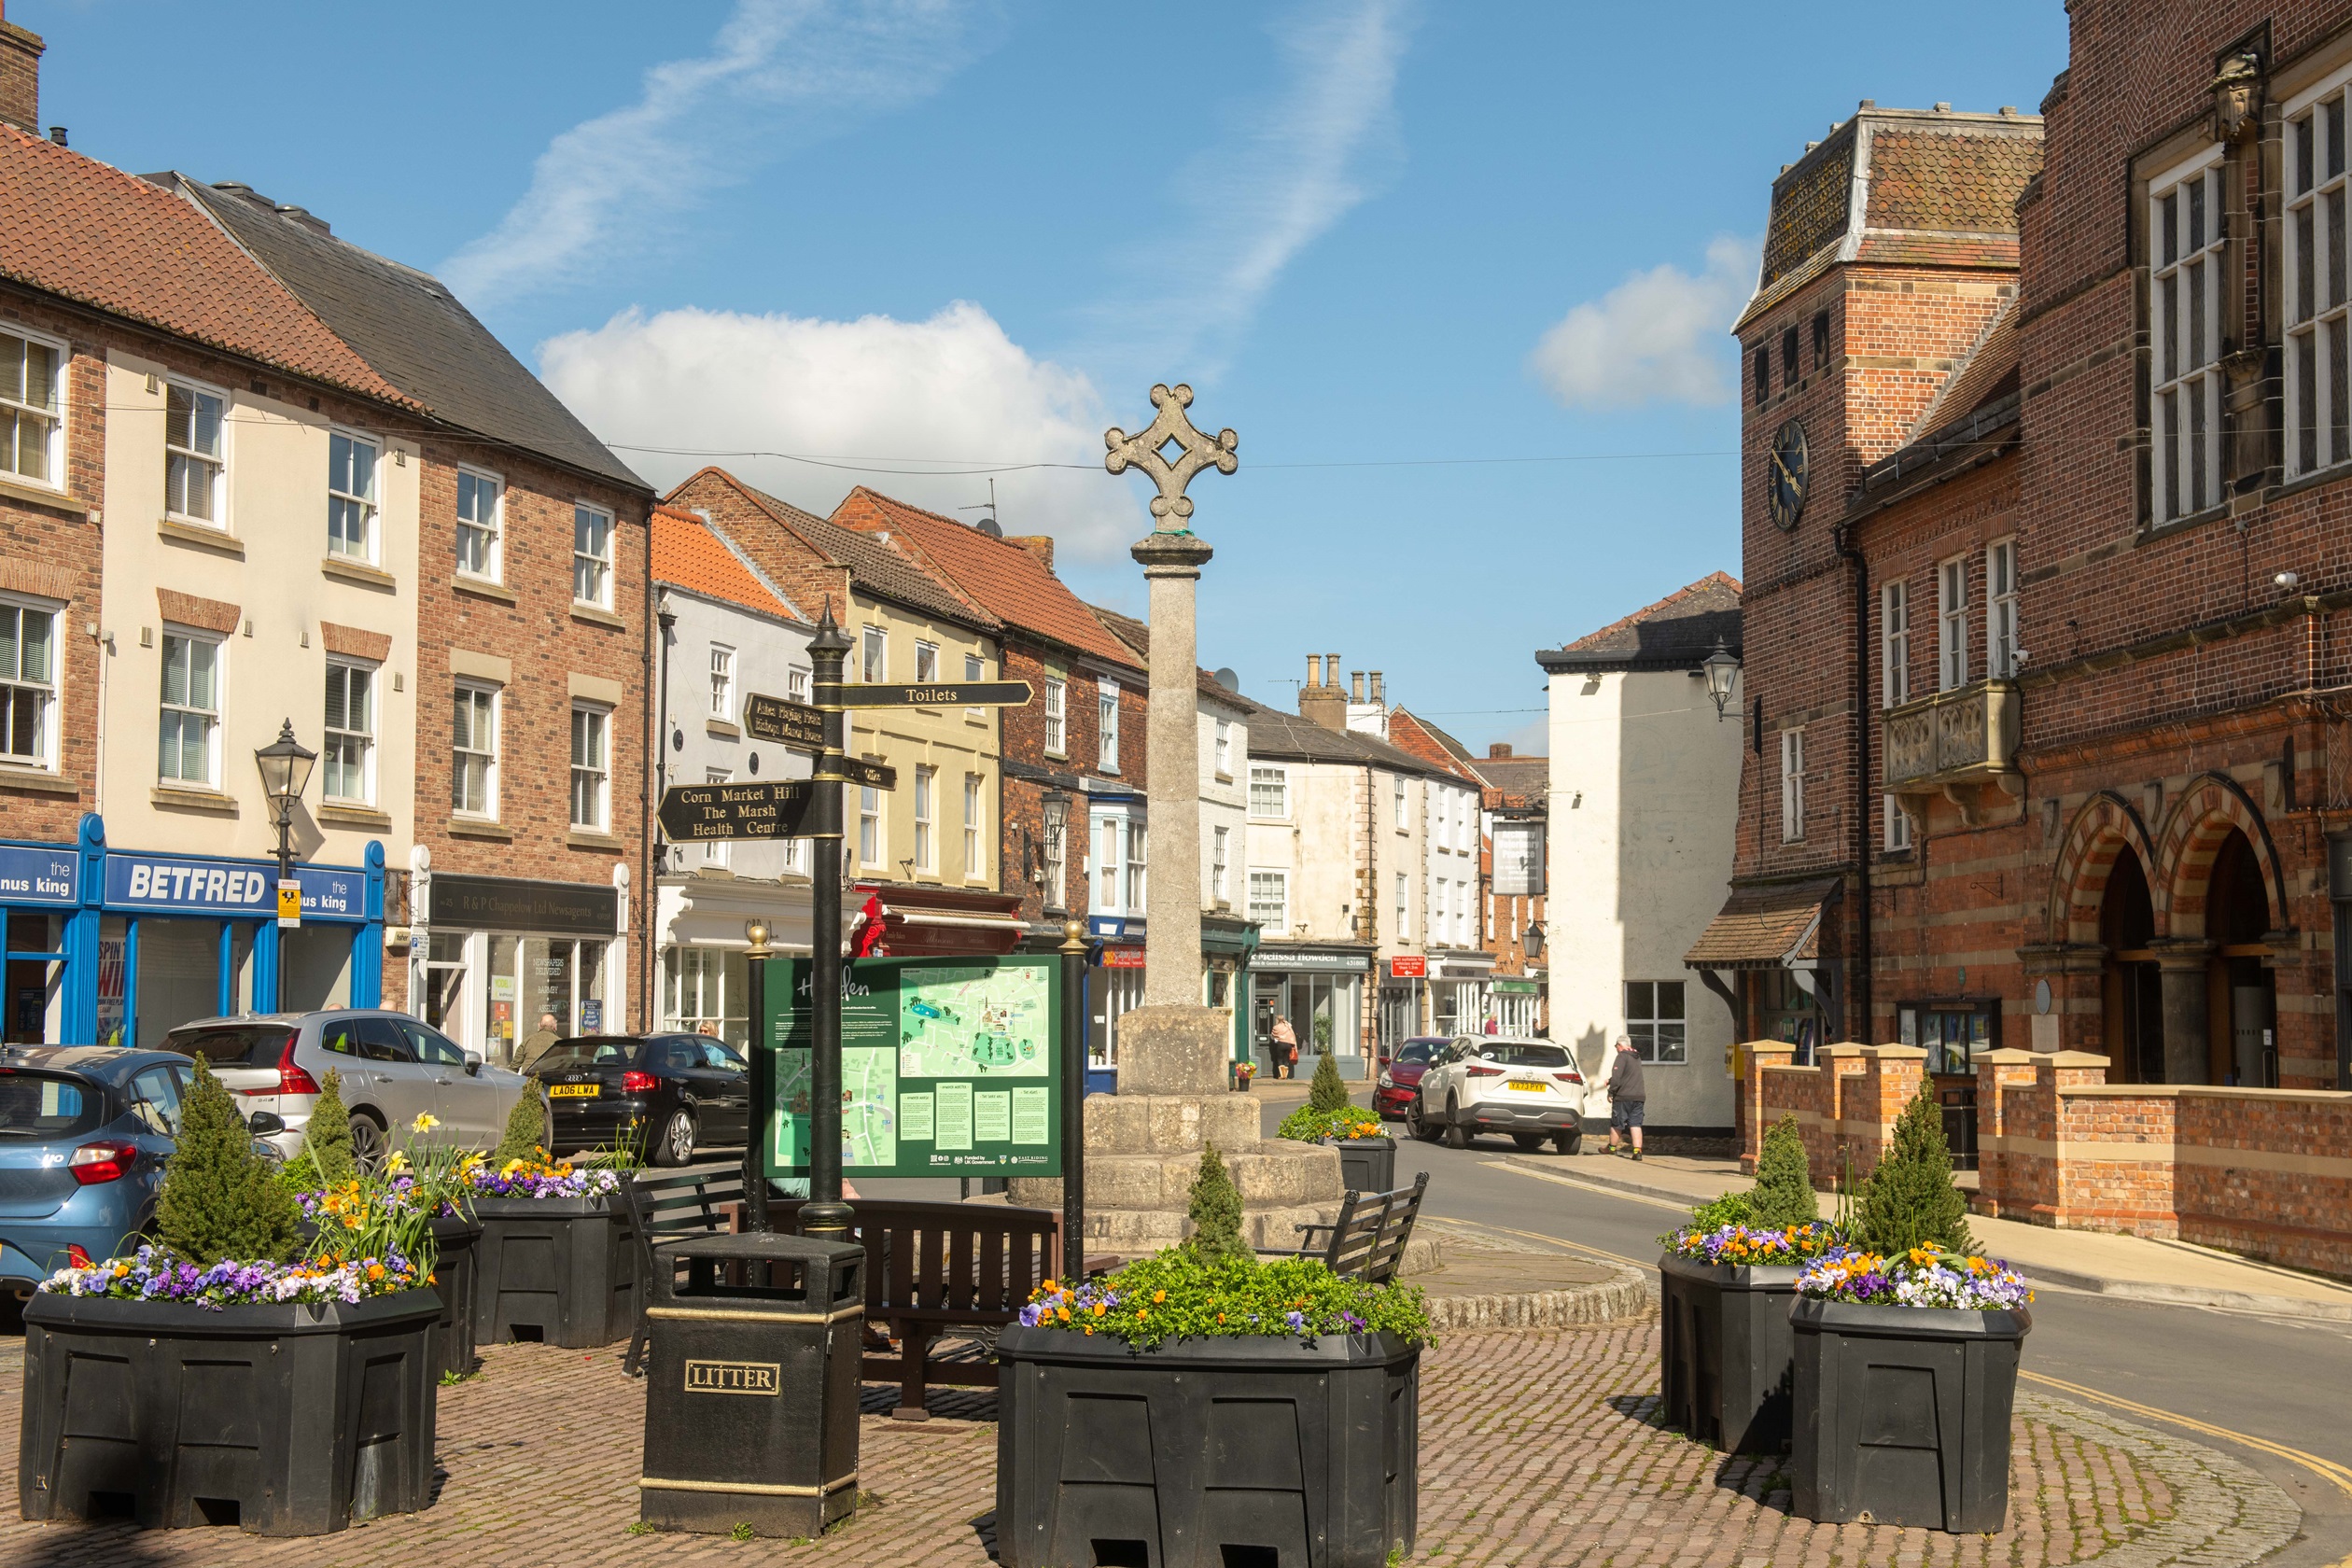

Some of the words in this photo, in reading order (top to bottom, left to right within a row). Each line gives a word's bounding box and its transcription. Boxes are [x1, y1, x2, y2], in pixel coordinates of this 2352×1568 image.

[905, 689, 958, 702] Toilets
[757, 701, 776, 717] Ashes
[778, 705, 803, 725] Playing
[804, 710, 821, 726] Fields
[755, 717, 779, 736] Bishops
[782, 722, 803, 739] Manor
[680, 791, 712, 804] Corn
[721, 789, 764, 803] Market
[773, 786, 800, 800] Hill
[703, 806, 726, 819] The
[737, 804, 777, 819] Marsh
[693, 822, 734, 836] Health
[747, 820, 789, 834] Centre
[50, 861, 70, 876] the
[36, 877, 70, 897] king
[129, 864, 265, 903] BETFRED
[332, 881, 347, 894] the
[321, 895, 346, 912] king
[463, 896, 469, 910] R
[471, 897, 478, 910] &
[481, 897, 487, 911] P
[488, 897, 531, 917] Chappelow
[534, 900, 547, 915] Ltd
[548, 902, 592, 920] Newsagents
[98, 941, 121, 960] SPIN
[1258, 952, 1295, 960] Melissa
[1297, 953, 1337, 962] Howden
[533, 958, 565, 967] NEWSPAPERS
[535, 967, 562, 976] DELIVERED
[797, 965, 870, 1001] Hden
[553, 1085, 576, 1096] LA06
[577, 1085, 594, 1095] LWA
[692, 1366, 772, 1389] LITTER
